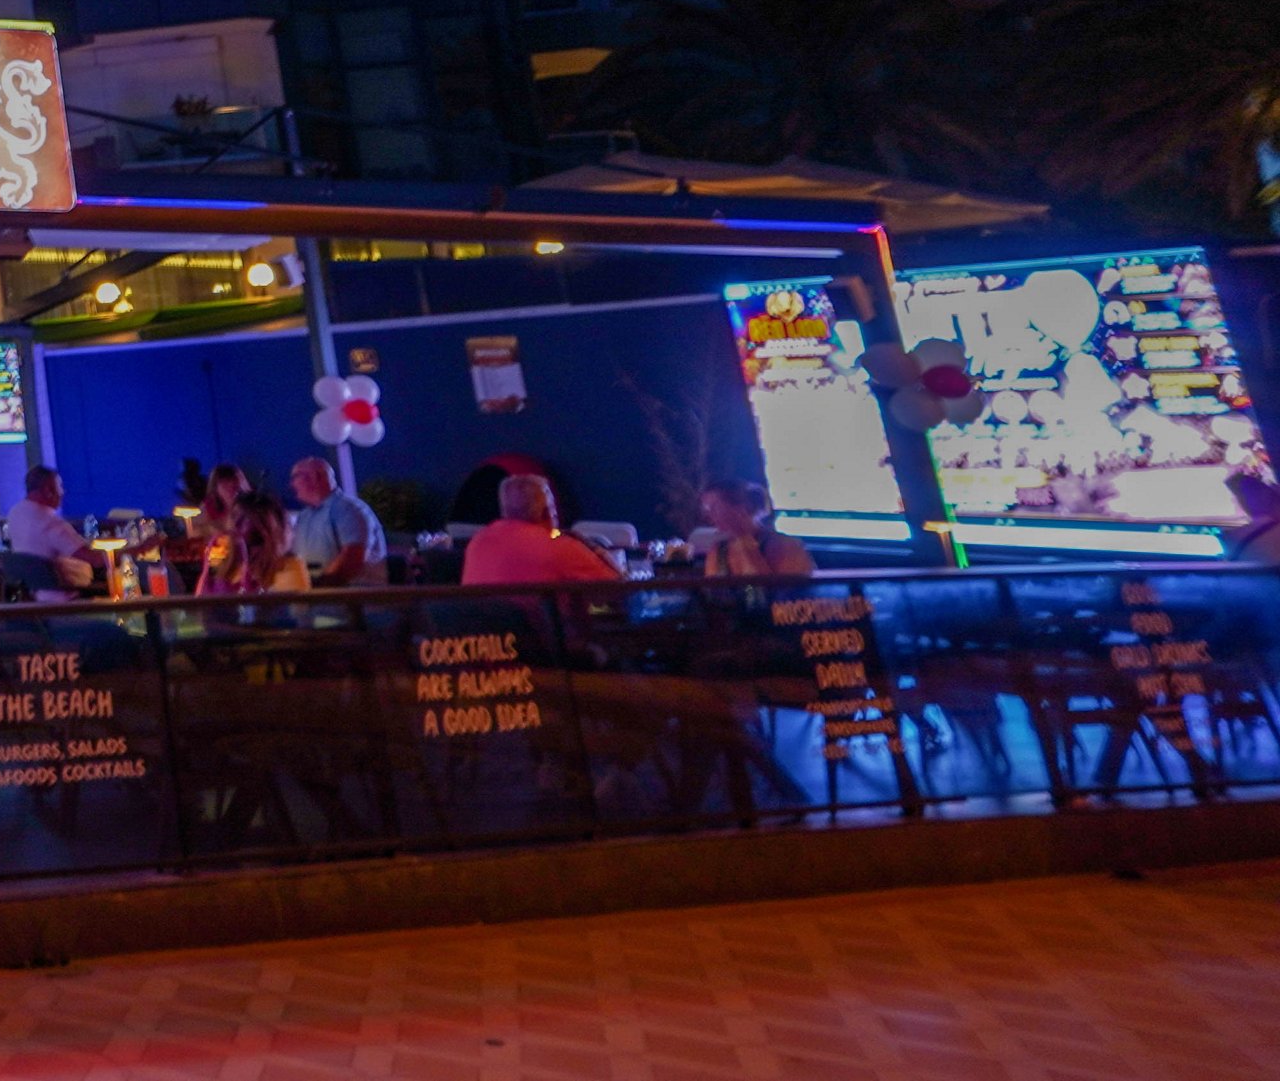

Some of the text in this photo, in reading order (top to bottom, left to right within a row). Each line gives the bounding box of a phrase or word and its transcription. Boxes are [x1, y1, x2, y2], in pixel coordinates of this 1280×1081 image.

[419, 632, 519, 667] COCKTAILS
[17, 652, 81, 683] TASTE
[417, 666, 535, 701] ARE ALWAYS
[42, 687, 114, 720] BEACH
[424, 701, 540, 737] A GOOD IDEA
[68, 737, 128, 758] SALADS
[62, 758, 146, 784] COCKTAILS
